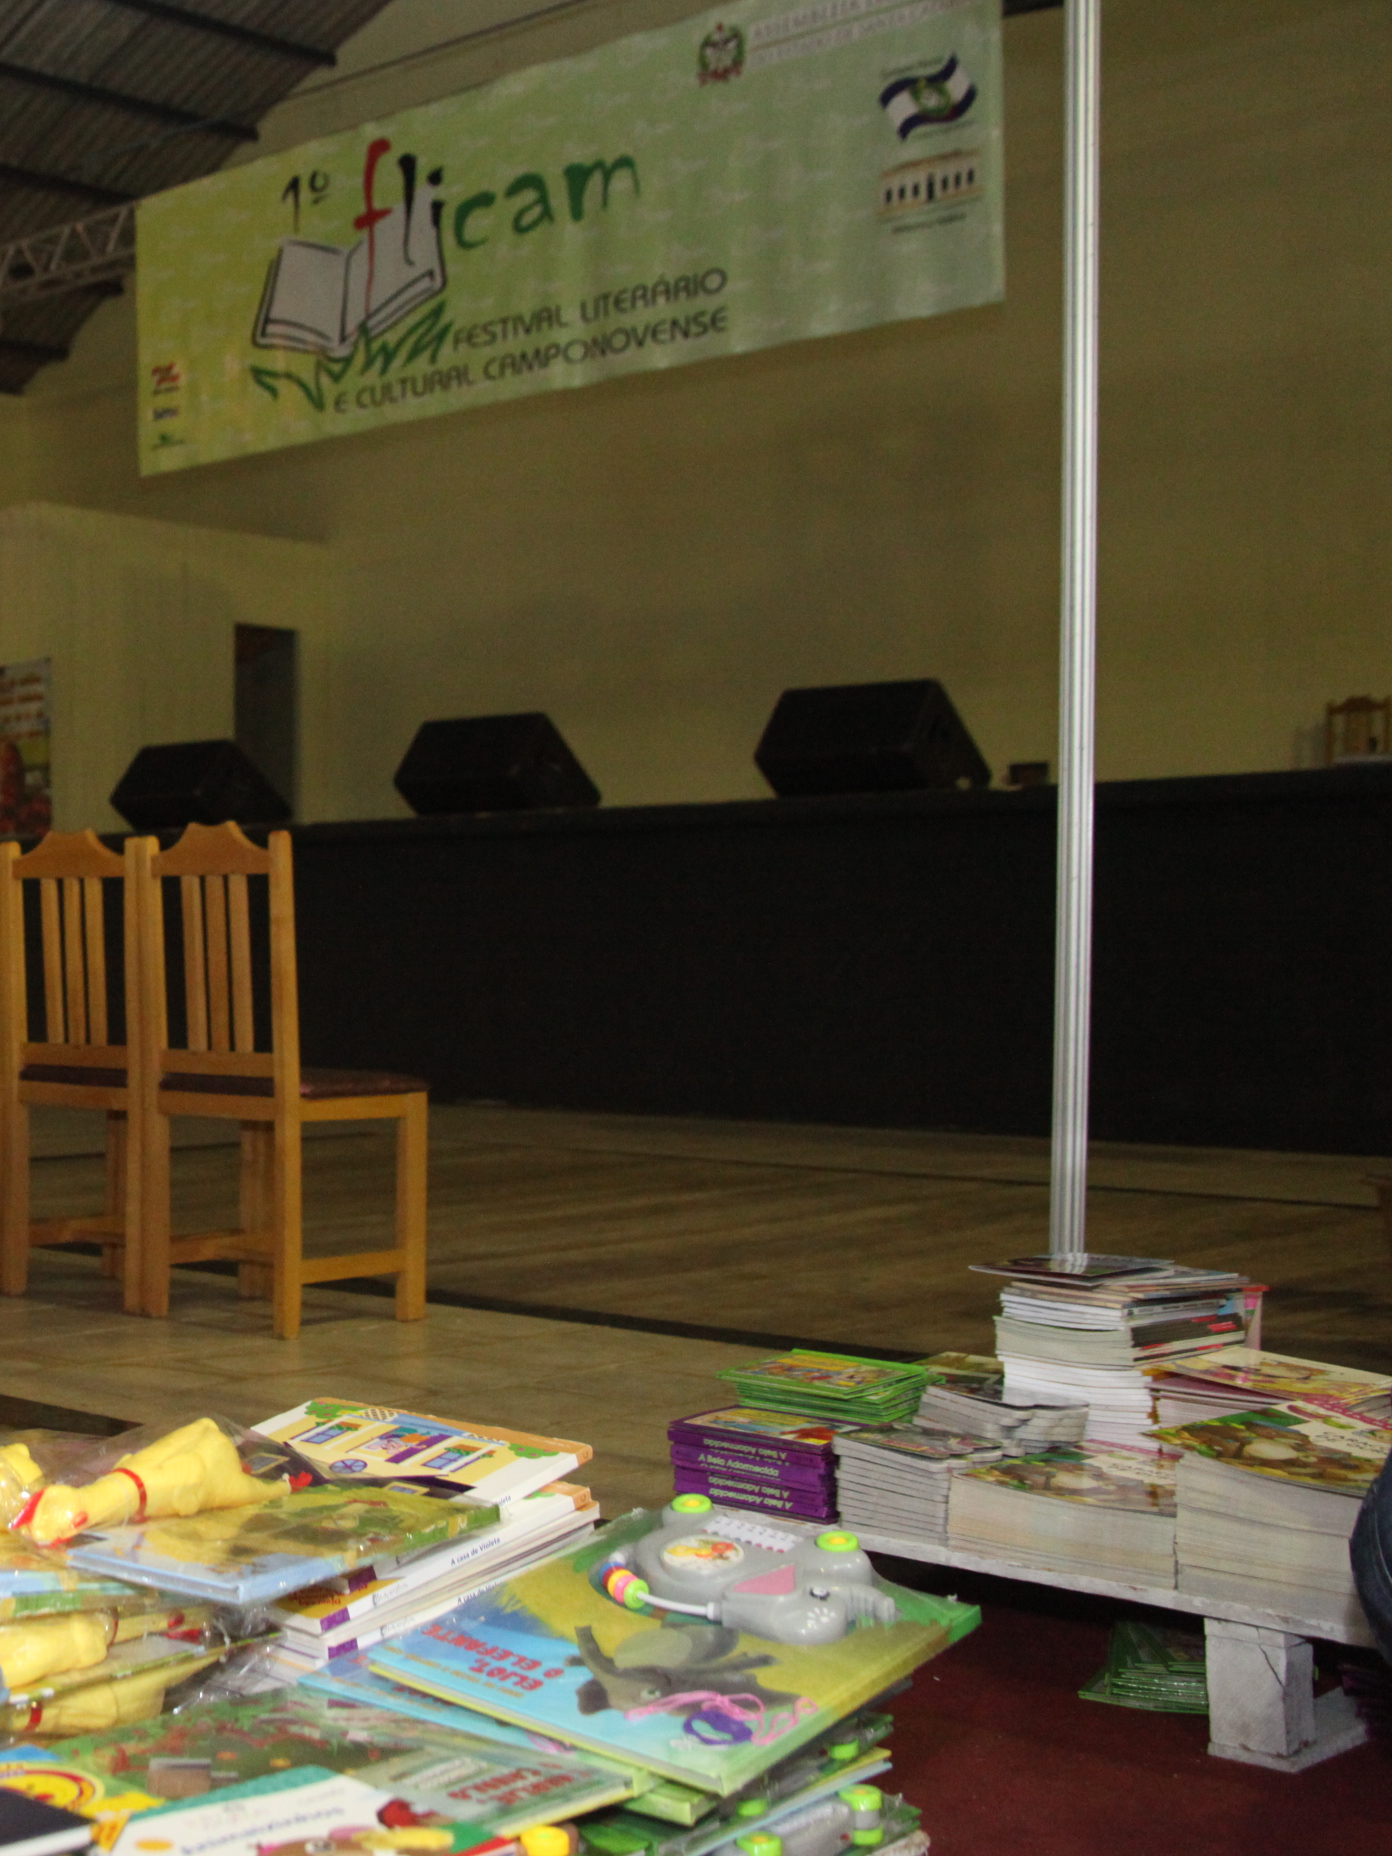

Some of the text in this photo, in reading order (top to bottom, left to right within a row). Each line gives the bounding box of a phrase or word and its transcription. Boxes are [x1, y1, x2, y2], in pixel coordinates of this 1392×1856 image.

[354, 138, 640, 268] flicam
[453, 267, 728, 352] FESTIVAL LITERÁRIO
[334, 304, 729, 414] E CULTURAL CAMPONOVENSE
[698, 1453, 780, 1477] A Bela Adormecida
[779, 1451, 787, 1460] A
[782, 1490, 790, 1499] A
[785, 1501, 794, 1510] A
[457, 1552, 470, 1563] casa
[471, 1547, 478, 1556] de
[479, 1537, 501, 1552] Violeta
[421, 1623, 542, 1672] ELEFANTE
[543, 1668, 565, 1679] O
